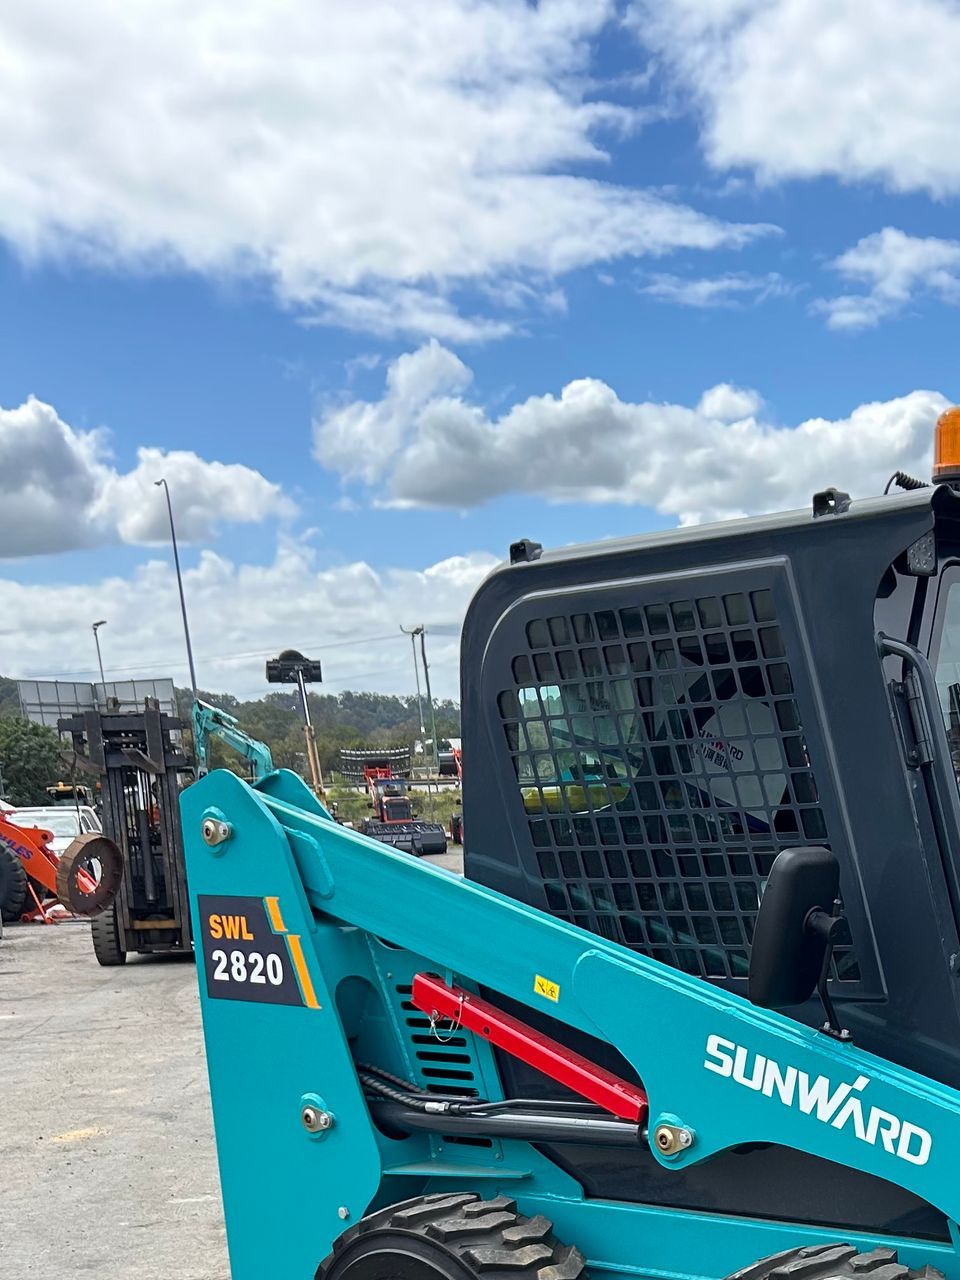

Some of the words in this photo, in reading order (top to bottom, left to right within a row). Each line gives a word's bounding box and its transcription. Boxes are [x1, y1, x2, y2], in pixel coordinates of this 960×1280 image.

[208, 914, 254, 941] SWL
[212, 949, 284, 986] 2820
[704, 1034, 932, 1166] SUNWARD
